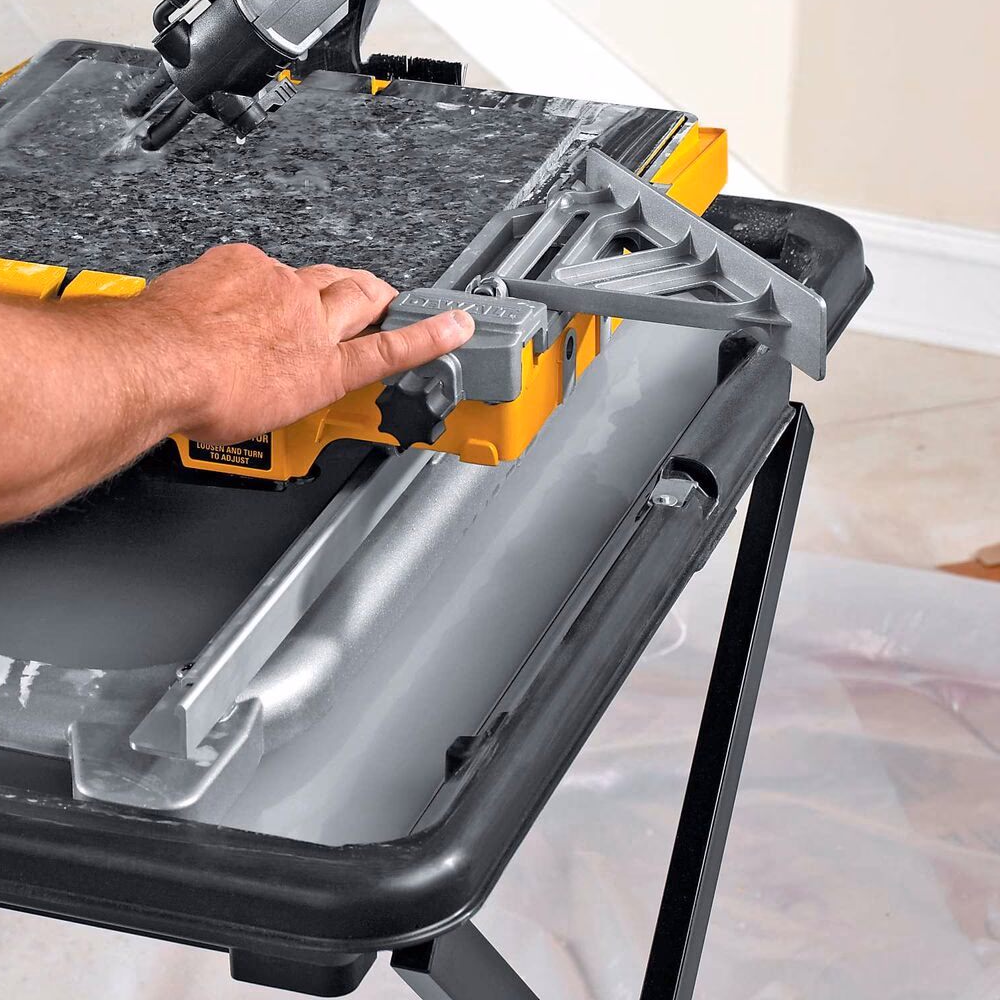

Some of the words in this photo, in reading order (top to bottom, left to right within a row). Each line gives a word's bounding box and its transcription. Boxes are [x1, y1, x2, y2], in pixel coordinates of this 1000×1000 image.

[210, 452, 220, 460] TO
[221, 454, 249, 464] ADJUST
[226, 446, 242, 455] AND
[243, 449, 263, 459] TURN
